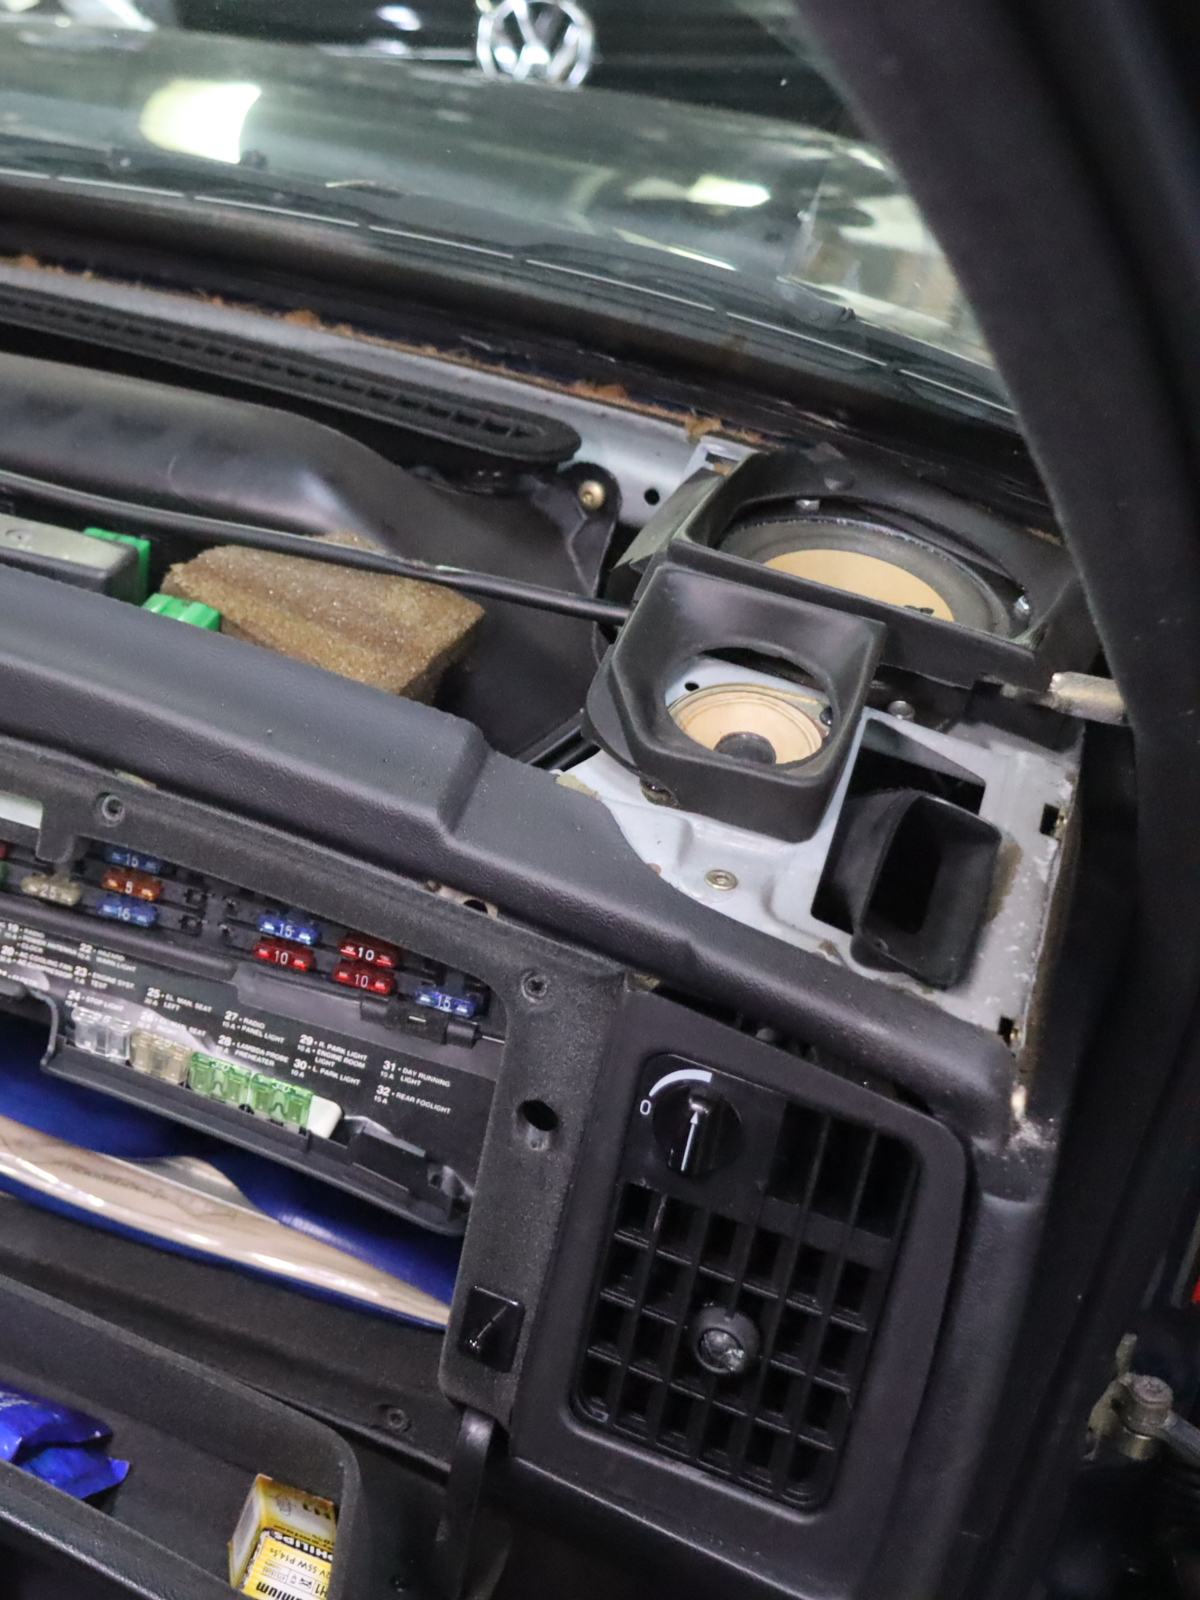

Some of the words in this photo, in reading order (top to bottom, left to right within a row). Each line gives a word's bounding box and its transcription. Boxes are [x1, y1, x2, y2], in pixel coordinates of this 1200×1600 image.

[125, 854, 139, 868] 15
[40, 884, 57, 900] 25
[125, 881, 133, 894] 5
[278, 923, 294, 938] 15
[0, 945, 14, 957] 20
[79, 943, 93, 954] 22
[97, 949, 125, 962] HAZARD
[274, 950, 289, 966] 10
[357, 947, 375, 962] 10
[74, 966, 88, 977] 23
[92, 972, 117, 984] ENGINE
[116, 962, 137, 972] LIGHT
[91, 979, 108, 990] TEST
[354, 974, 369, 989] 10
[67, 990, 81, 1002] 24
[86, 996, 104, 1006] STOP
[103, 1001, 124, 1012] LIGHT
[146, 987, 161, 999] 25
[194, 1002, 213, 1013] SEAT
[163, 1001, 180, 1012] LEFT
[438, 994, 451, 1010] 15
[92, 1012, 112, 1024] 25
[224, 1010, 238, 1022] 27
[243, 1017, 266, 1030] RADIO
[188, 1026, 207, 1037] SEAT
[241, 1025, 263, 1038] PANEL
[264, 1032, 285, 1044] LIGHT
[218, 1034, 232, 1047] 28
[236, 1042, 265, 1056] LAMBDA
[265, 1049, 289, 1063] PROBE
[299, 1034, 314, 1046] 29
[326, 1043, 346, 1055] PARK
[347, 1048, 368, 1061] LIGHT
[234, 1049, 275, 1067] PREHEATER
[314, 1056, 336, 1068] LIGHT
[316, 1049, 343, 1064] ENGINE
[343, 1056, 366, 1069] ROOM
[293, 1058, 308, 1070] 30
[319, 1067, 339, 1079] PARK
[339, 1072, 361, 1086] LIGHT
[382, 1060, 396, 1072] 31
[402, 1067, 417, 1077] DAY
[417, 1071, 451, 1088] RUNNING
[271, 1082, 291, 1093] 30
[400, 1075, 422, 1087] LIGHT
[376, 1085, 391, 1097] 32
[395, 1091, 416, 1104] REAR
[415, 1096, 451, 1115] FOGLIGHT
[297, 1558, 318, 1574] 55W
